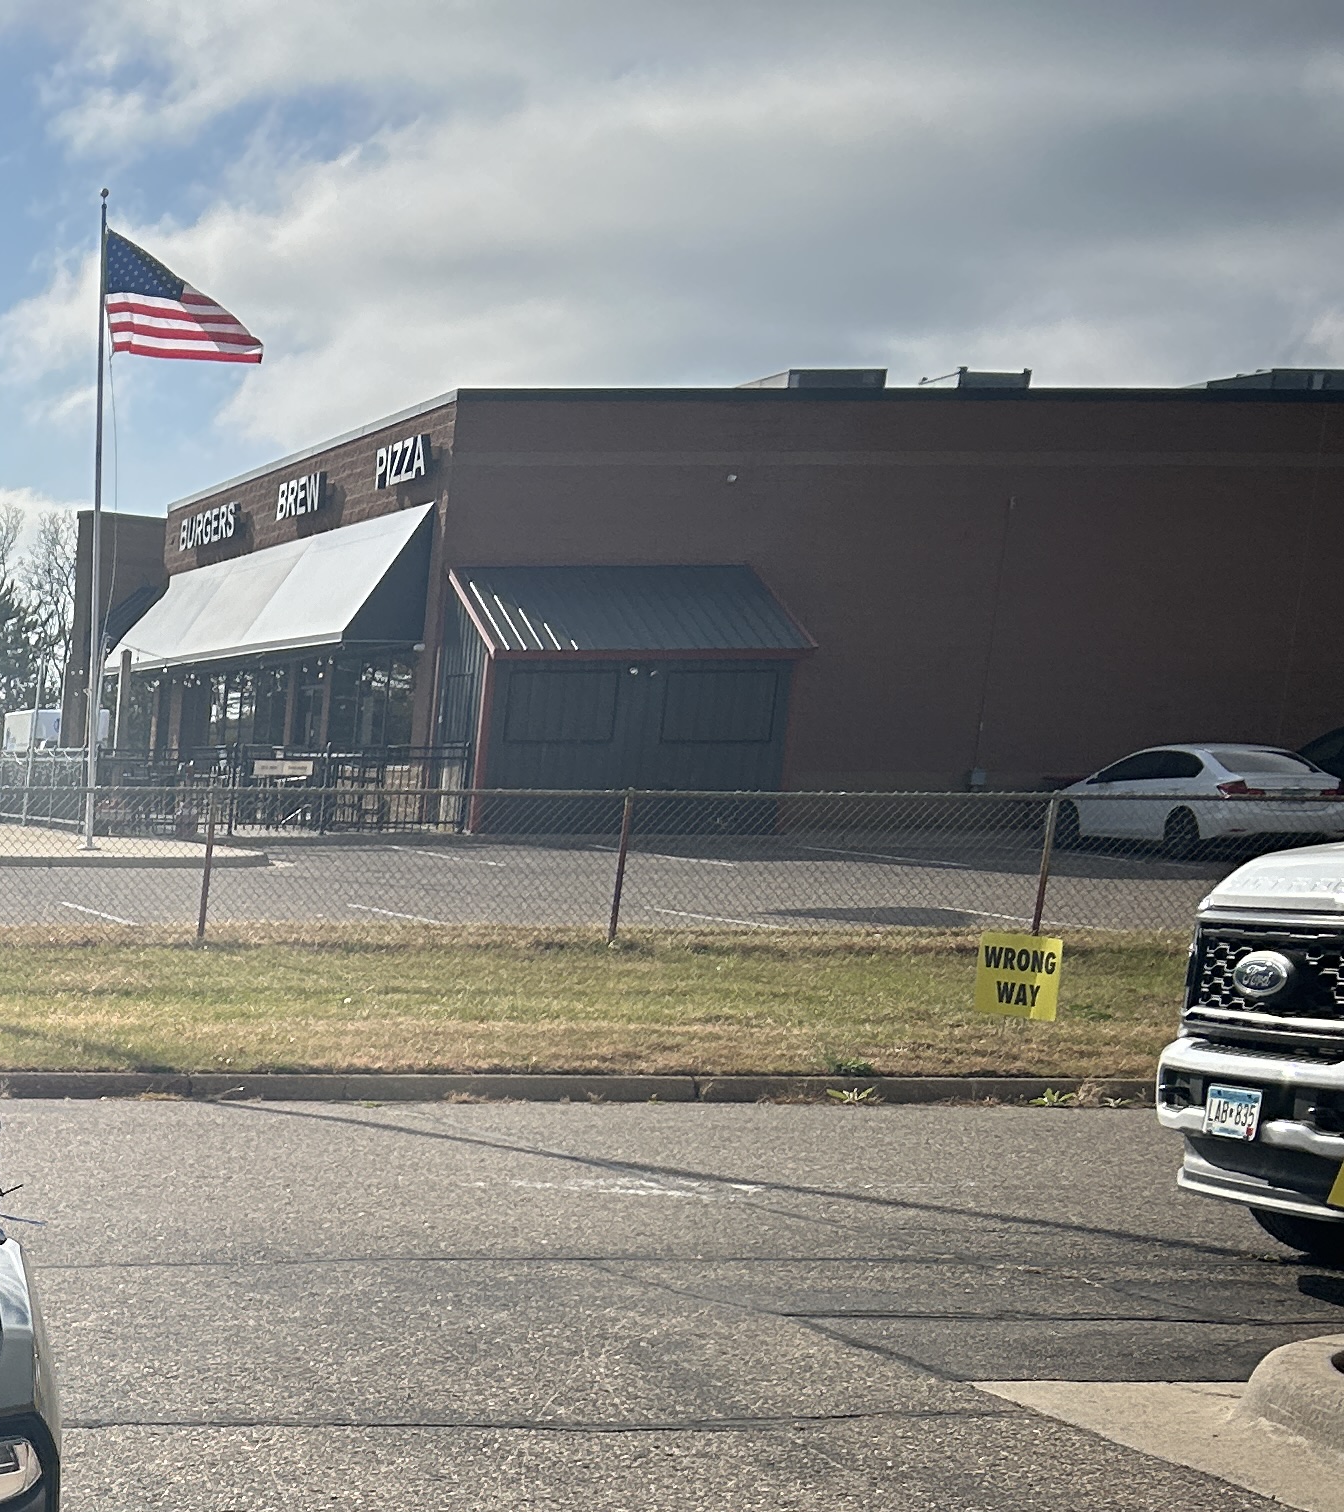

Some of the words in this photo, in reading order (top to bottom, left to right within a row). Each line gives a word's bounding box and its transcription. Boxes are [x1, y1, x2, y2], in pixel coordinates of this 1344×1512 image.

[375, 434, 426, 491] PIZZA
[275, 472, 322, 522] BREW
[179, 502, 235, 552] BURGERS
[984, 945, 1056, 975] WRONG
[1243, 964, 1274, 987] Ford
[996, 980, 1041, 1007] WAY
